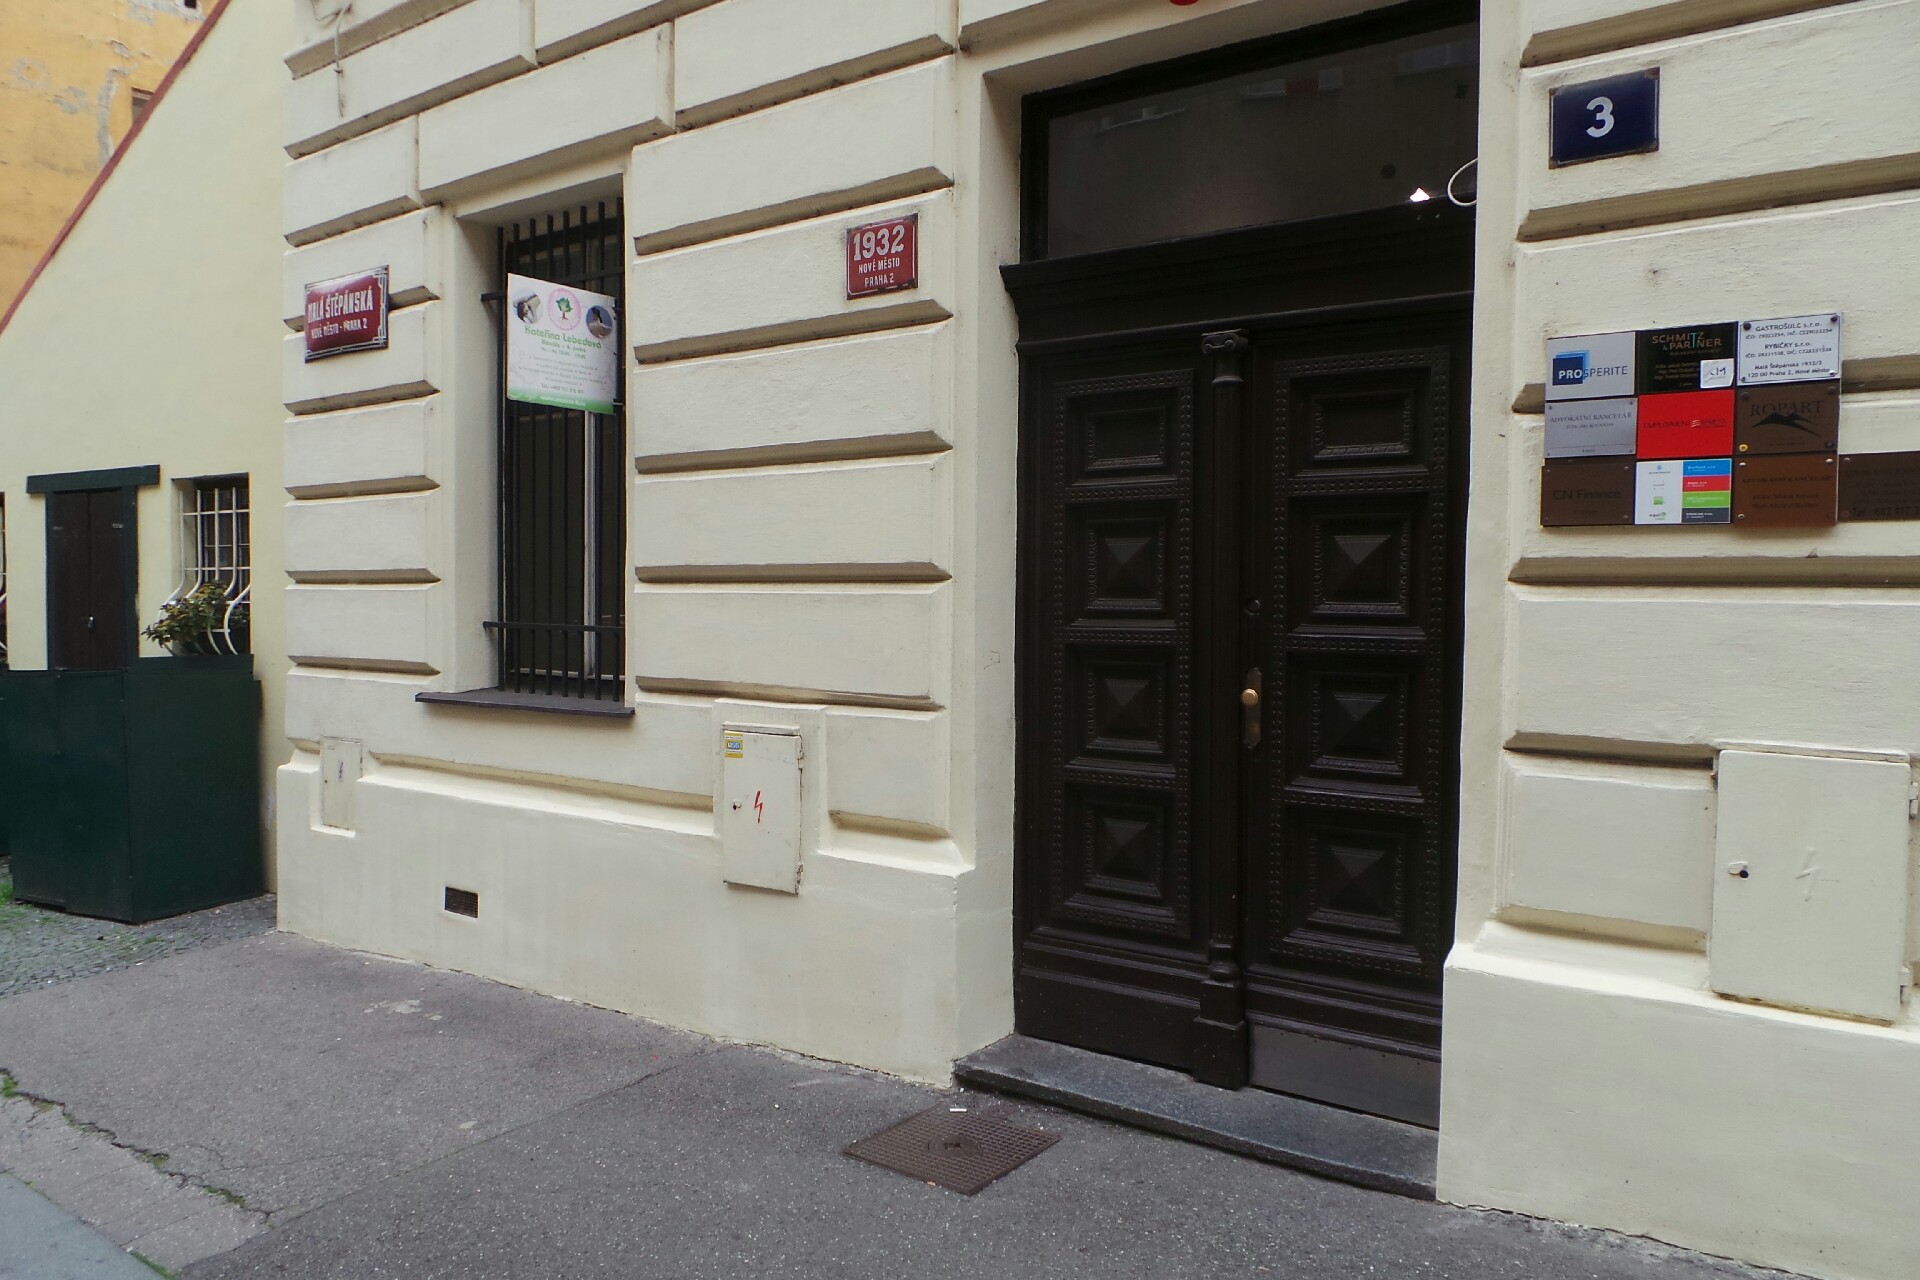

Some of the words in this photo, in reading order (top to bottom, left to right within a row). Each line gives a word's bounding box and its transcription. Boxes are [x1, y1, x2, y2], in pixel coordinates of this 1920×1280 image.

[1586, 96, 1615, 138] 3
[853, 224, 905, 261] 1932
[858, 258, 876, 275] NOVÉ
[877, 256, 900, 271] MĚSTO
[864, 274, 888, 288] PRAHA
[889, 272, 895, 284] 2
[308, 296, 325, 324] MALÁ
[325, 285, 373, 319] ŠTĚPÁNSKÁ
[311, 324, 323, 339] NOVÉ
[323, 322, 339, 336] MĚSTO
[343, 319, 362, 332] PRAHA
[362, 317, 368, 329] 2
[524, 325, 560, 341] Kateřina
[1558, 365, 1629, 380] PROSPERITE
[1750, 400, 1825, 416] ROPART
[1576, 487, 1623, 500] Finance
